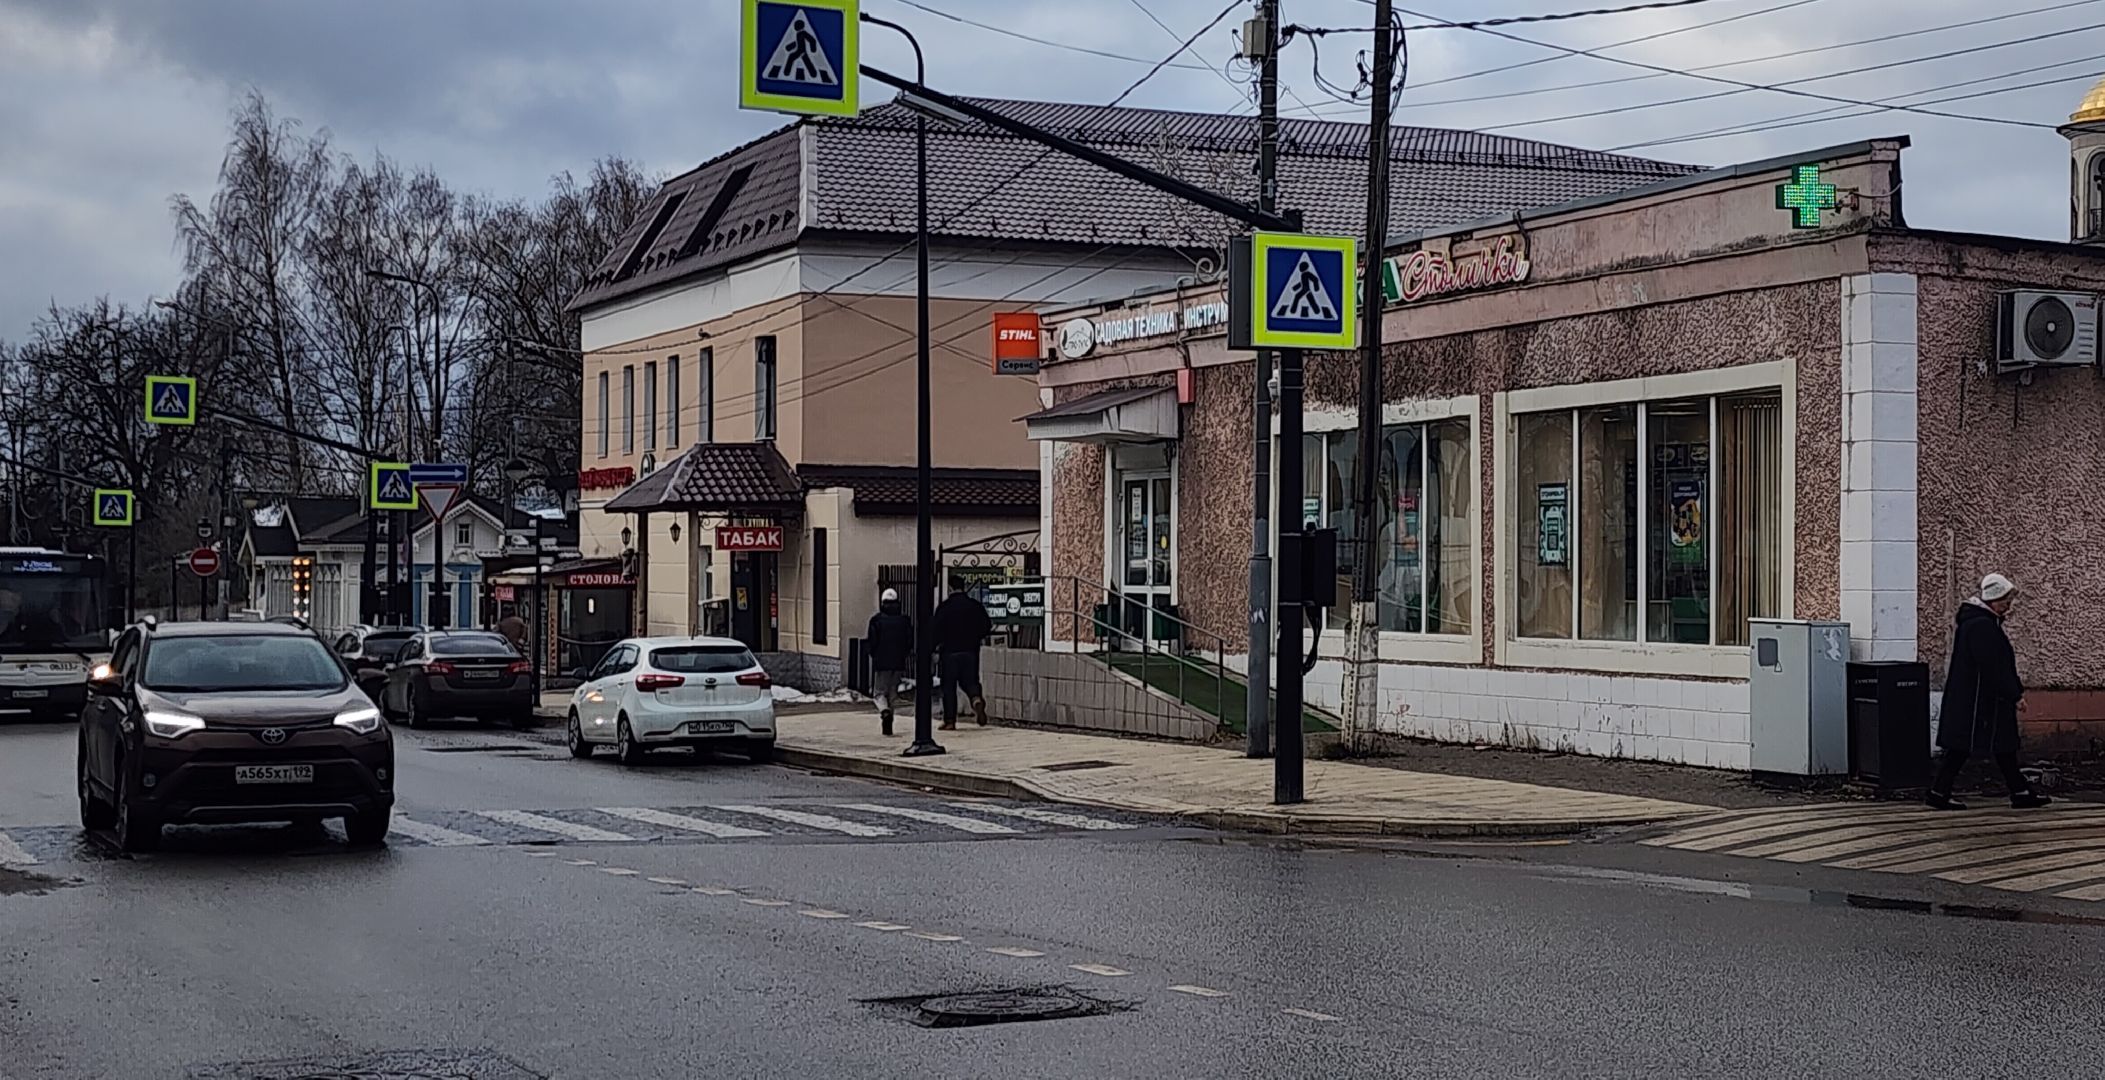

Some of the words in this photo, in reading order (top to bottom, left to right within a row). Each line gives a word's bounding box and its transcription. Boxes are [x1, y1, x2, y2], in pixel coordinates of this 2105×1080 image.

[1402, 235, 1526, 302] Столички
[1095, 319, 1133, 345] САДОВАЯ
[1135, 311, 1175, 341] ТЕХНИКА
[1184, 301, 1229, 330] ИНСТРУМ
[999, 329, 1037, 341] STIHL
[1002, 360, 1034, 371] Сервис
[720, 531, 780, 546] ТАБАК
